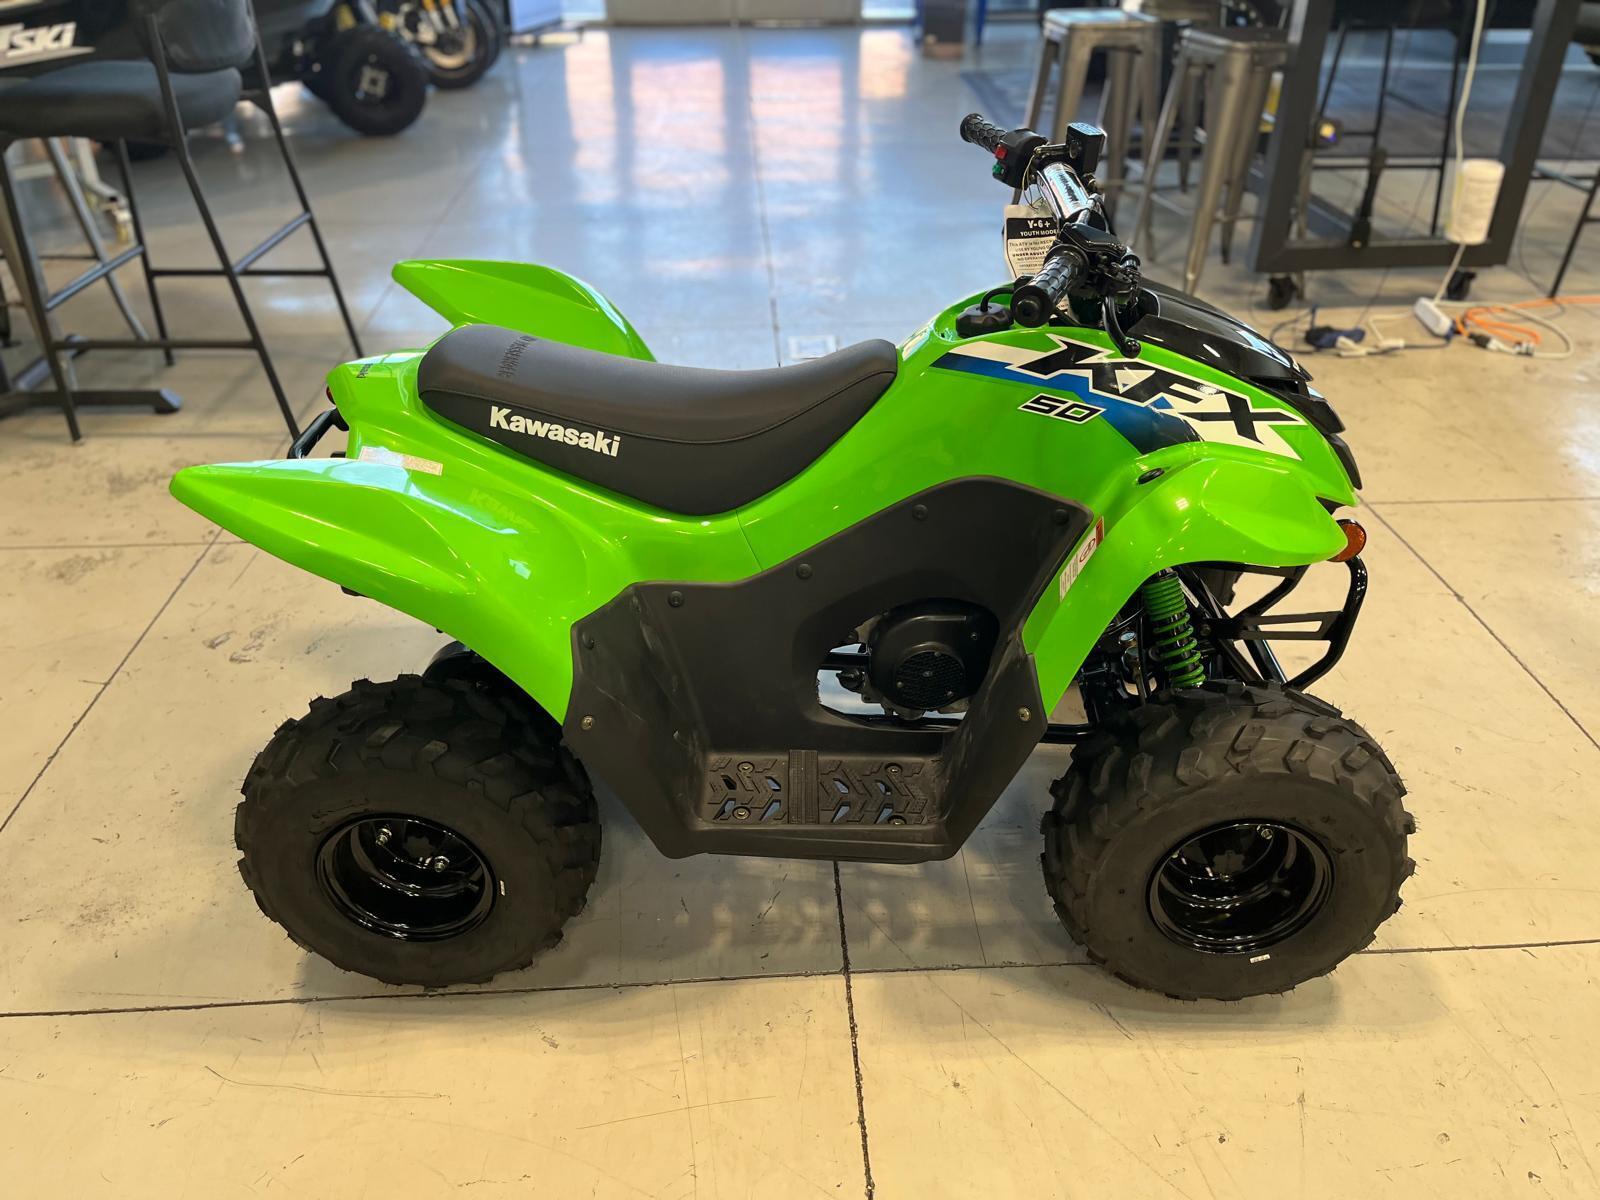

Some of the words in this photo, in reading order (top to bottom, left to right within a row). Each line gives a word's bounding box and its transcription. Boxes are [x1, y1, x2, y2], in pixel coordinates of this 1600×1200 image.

[1014, 335, 1303, 449] KFX
[1020, 394, 1102, 423] 50
[489, 405, 621, 458] Kawasaki
